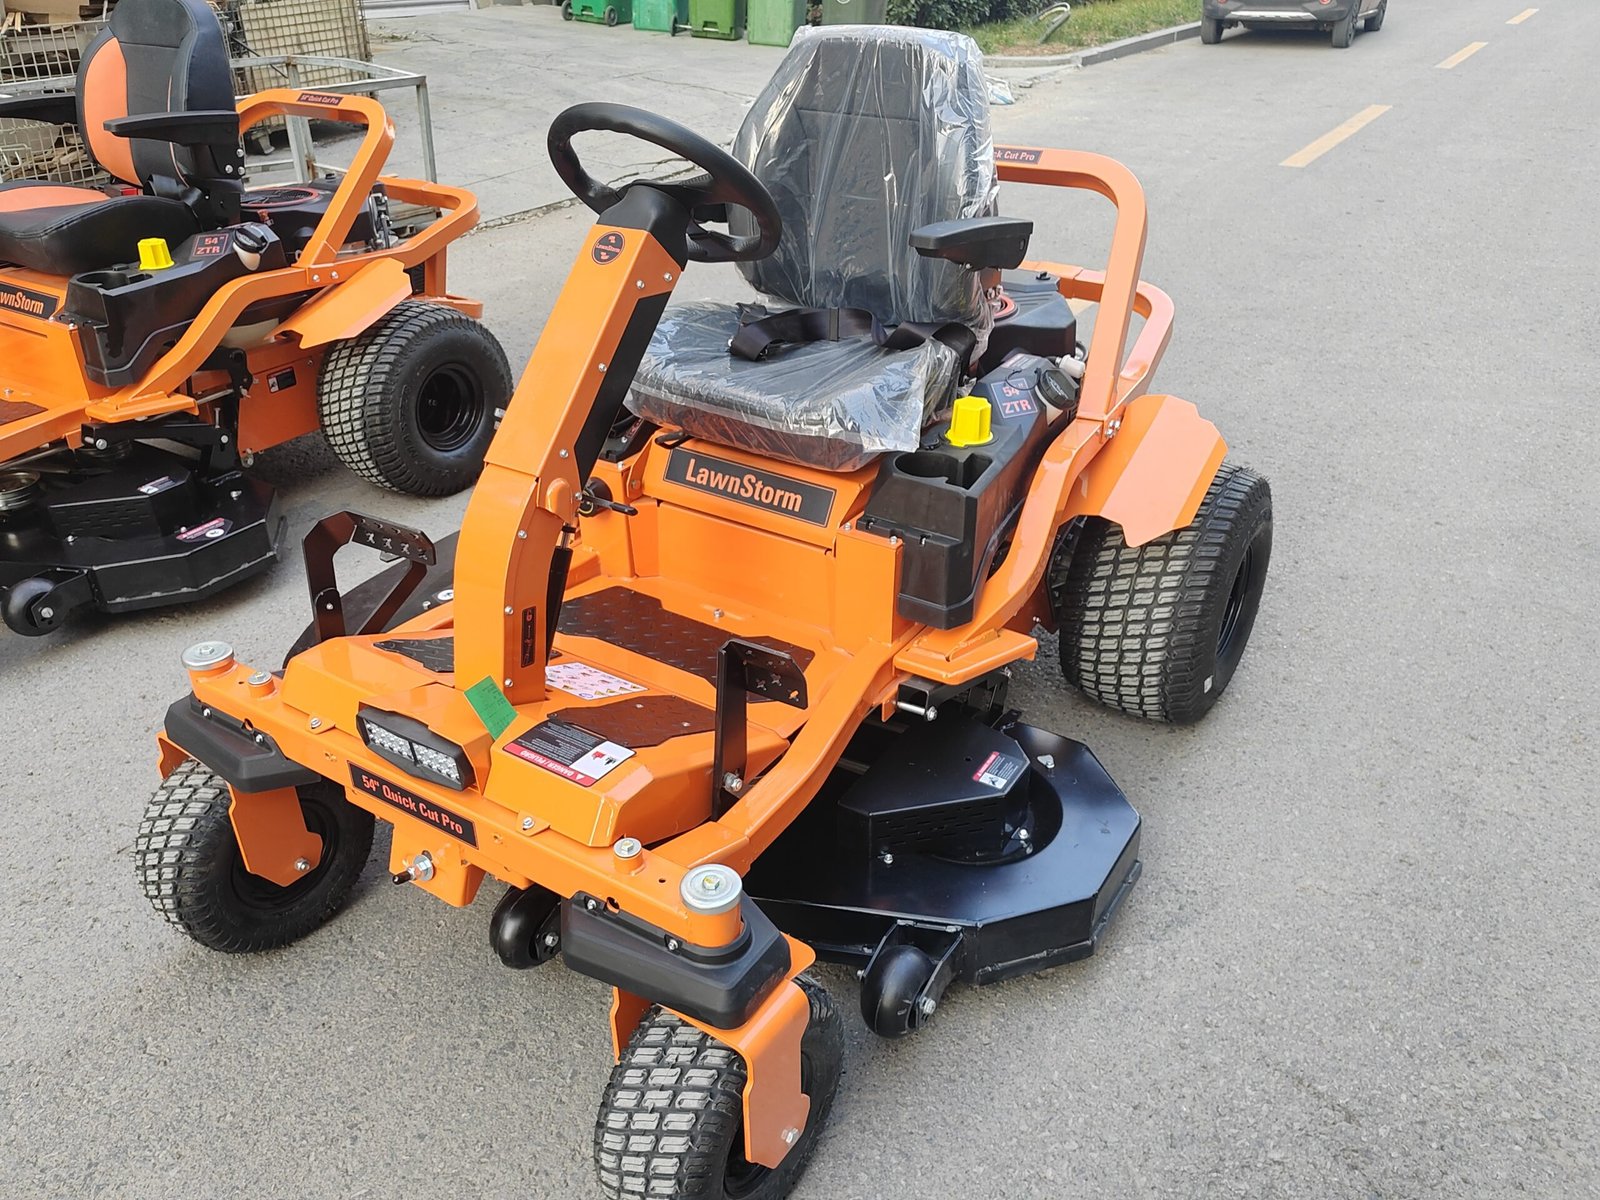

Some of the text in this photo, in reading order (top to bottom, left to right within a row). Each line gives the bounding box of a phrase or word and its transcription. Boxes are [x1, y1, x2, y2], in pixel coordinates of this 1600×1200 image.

[1003, 150, 1019, 160] Cut
[1020, 152, 1035, 161] Pro
[196, 245, 221, 255] ZTR
[0, 291, 45, 315] wnStorm
[1001, 399, 1032, 414] ZTR
[685, 458, 803, 513] LawnStorm
[361, 774, 464, 835] 54" Quick Cut Pro
